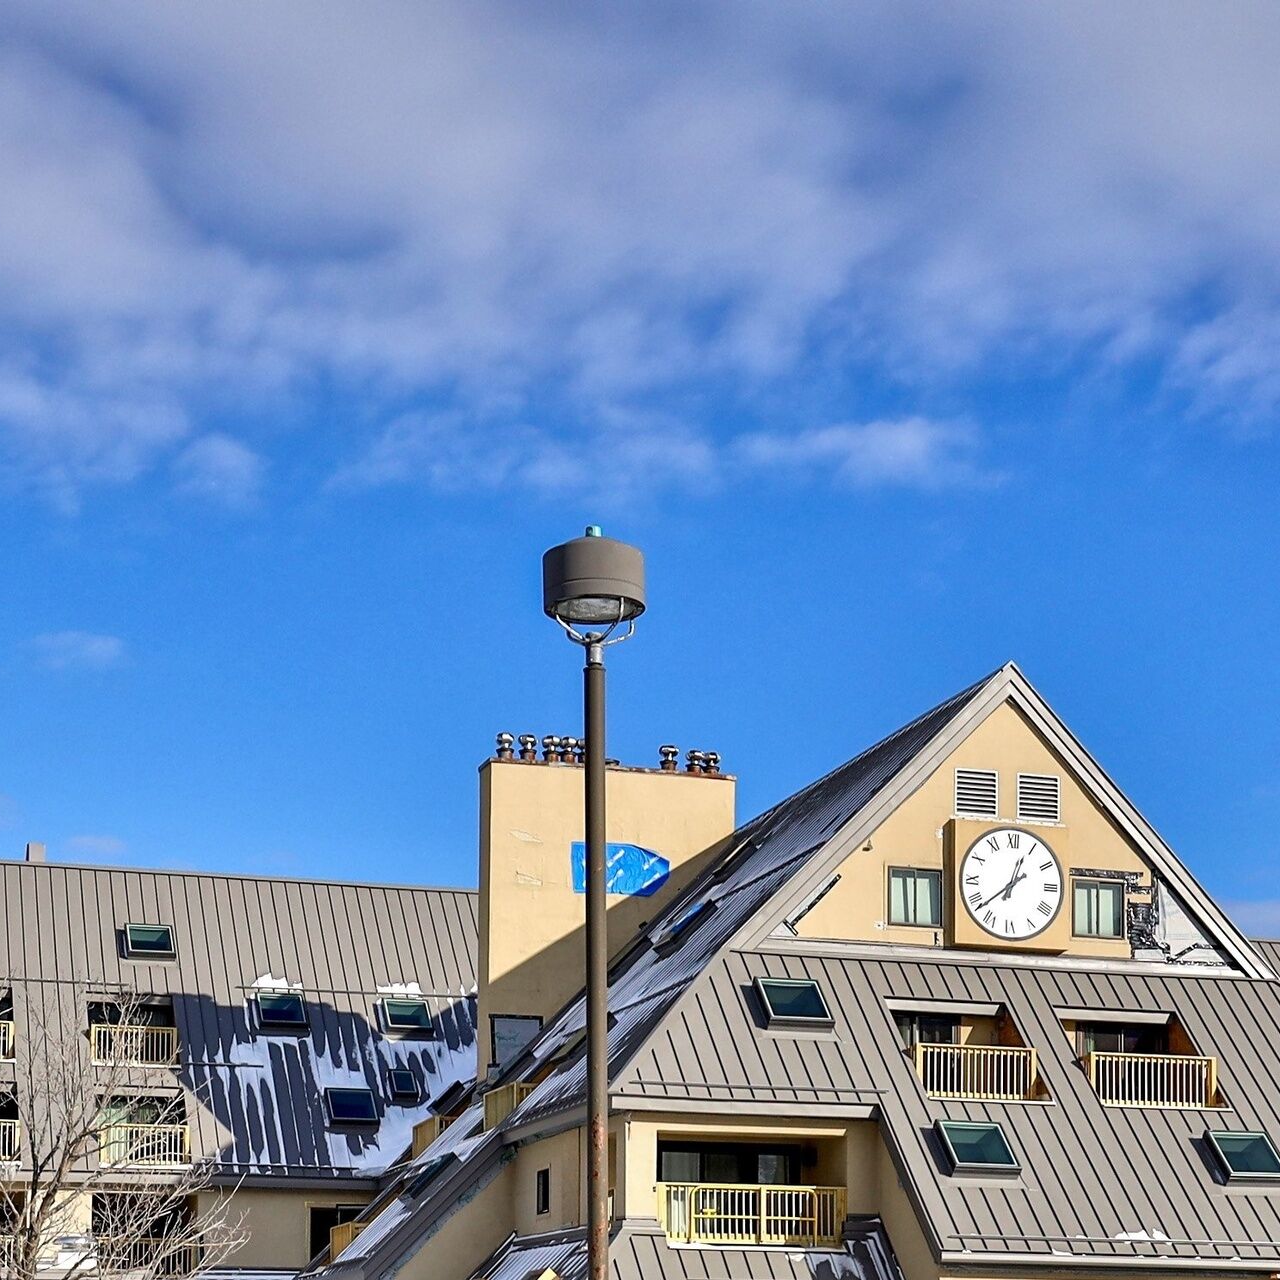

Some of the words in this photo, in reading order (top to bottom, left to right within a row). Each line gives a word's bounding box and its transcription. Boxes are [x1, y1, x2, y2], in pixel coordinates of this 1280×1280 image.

[986, 836, 1000, 853] XI
[1007, 833, 1019, 849] XII
[971, 852, 985, 866] X
[1039, 861, 1053, 871] II
[965, 874, 979, 885] IX
[1043, 883, 1058, 893] III
